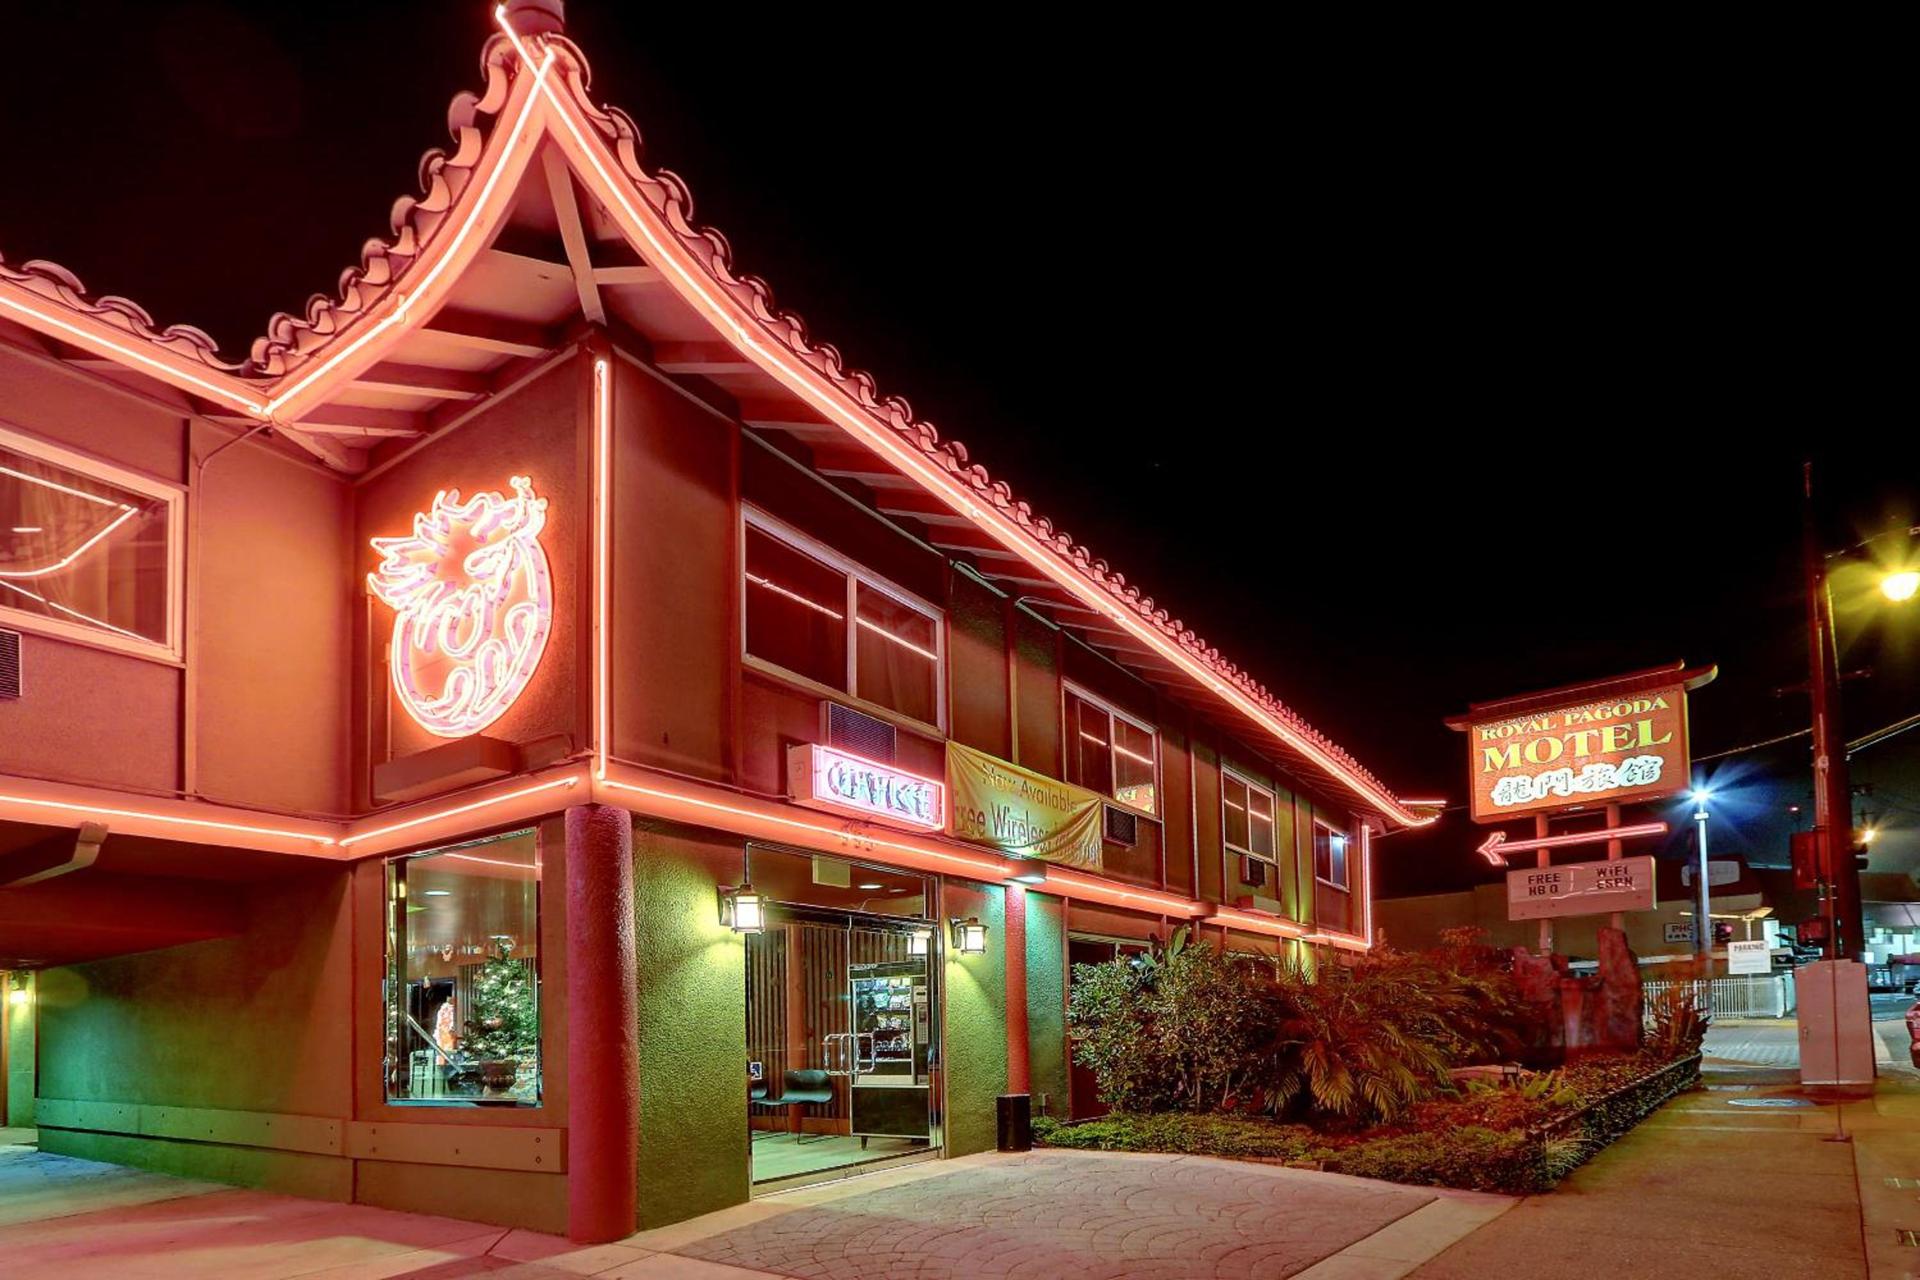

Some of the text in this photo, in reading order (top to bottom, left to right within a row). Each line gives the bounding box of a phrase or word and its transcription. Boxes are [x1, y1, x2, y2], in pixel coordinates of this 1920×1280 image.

[1481, 697, 1670, 742] ROYAL PAGODA
[1481, 719, 1673, 773] MOTEL
[1527, 872, 1561, 885] FREE
